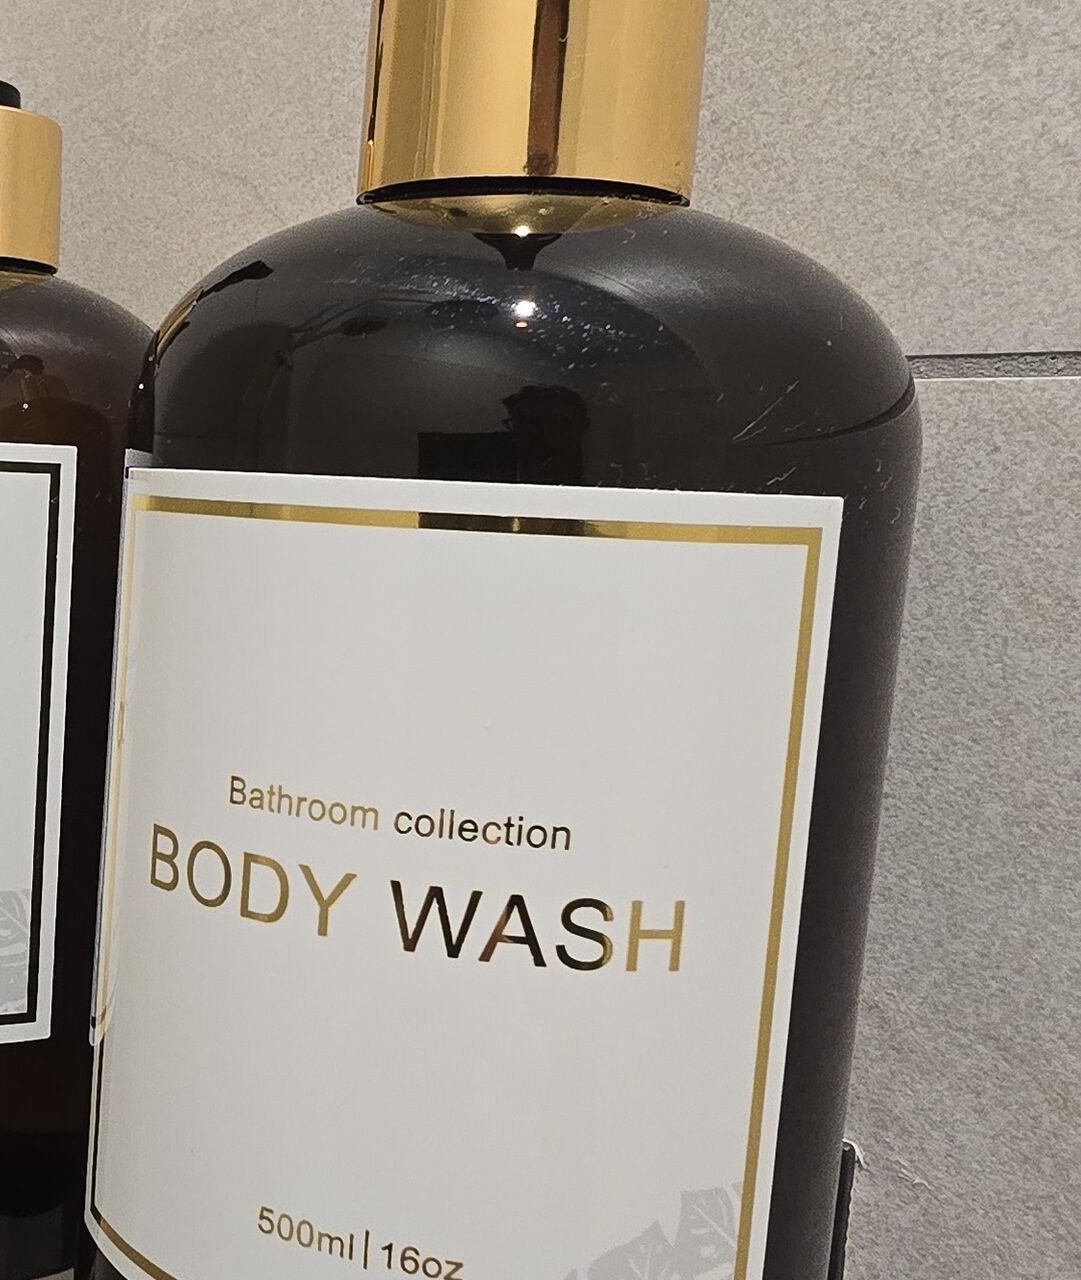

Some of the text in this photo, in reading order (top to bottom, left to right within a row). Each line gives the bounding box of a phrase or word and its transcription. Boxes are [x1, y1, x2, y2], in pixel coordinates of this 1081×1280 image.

[228, 773, 572, 851] Bathroom collection
[149, 823, 686, 973] BODY WASH
